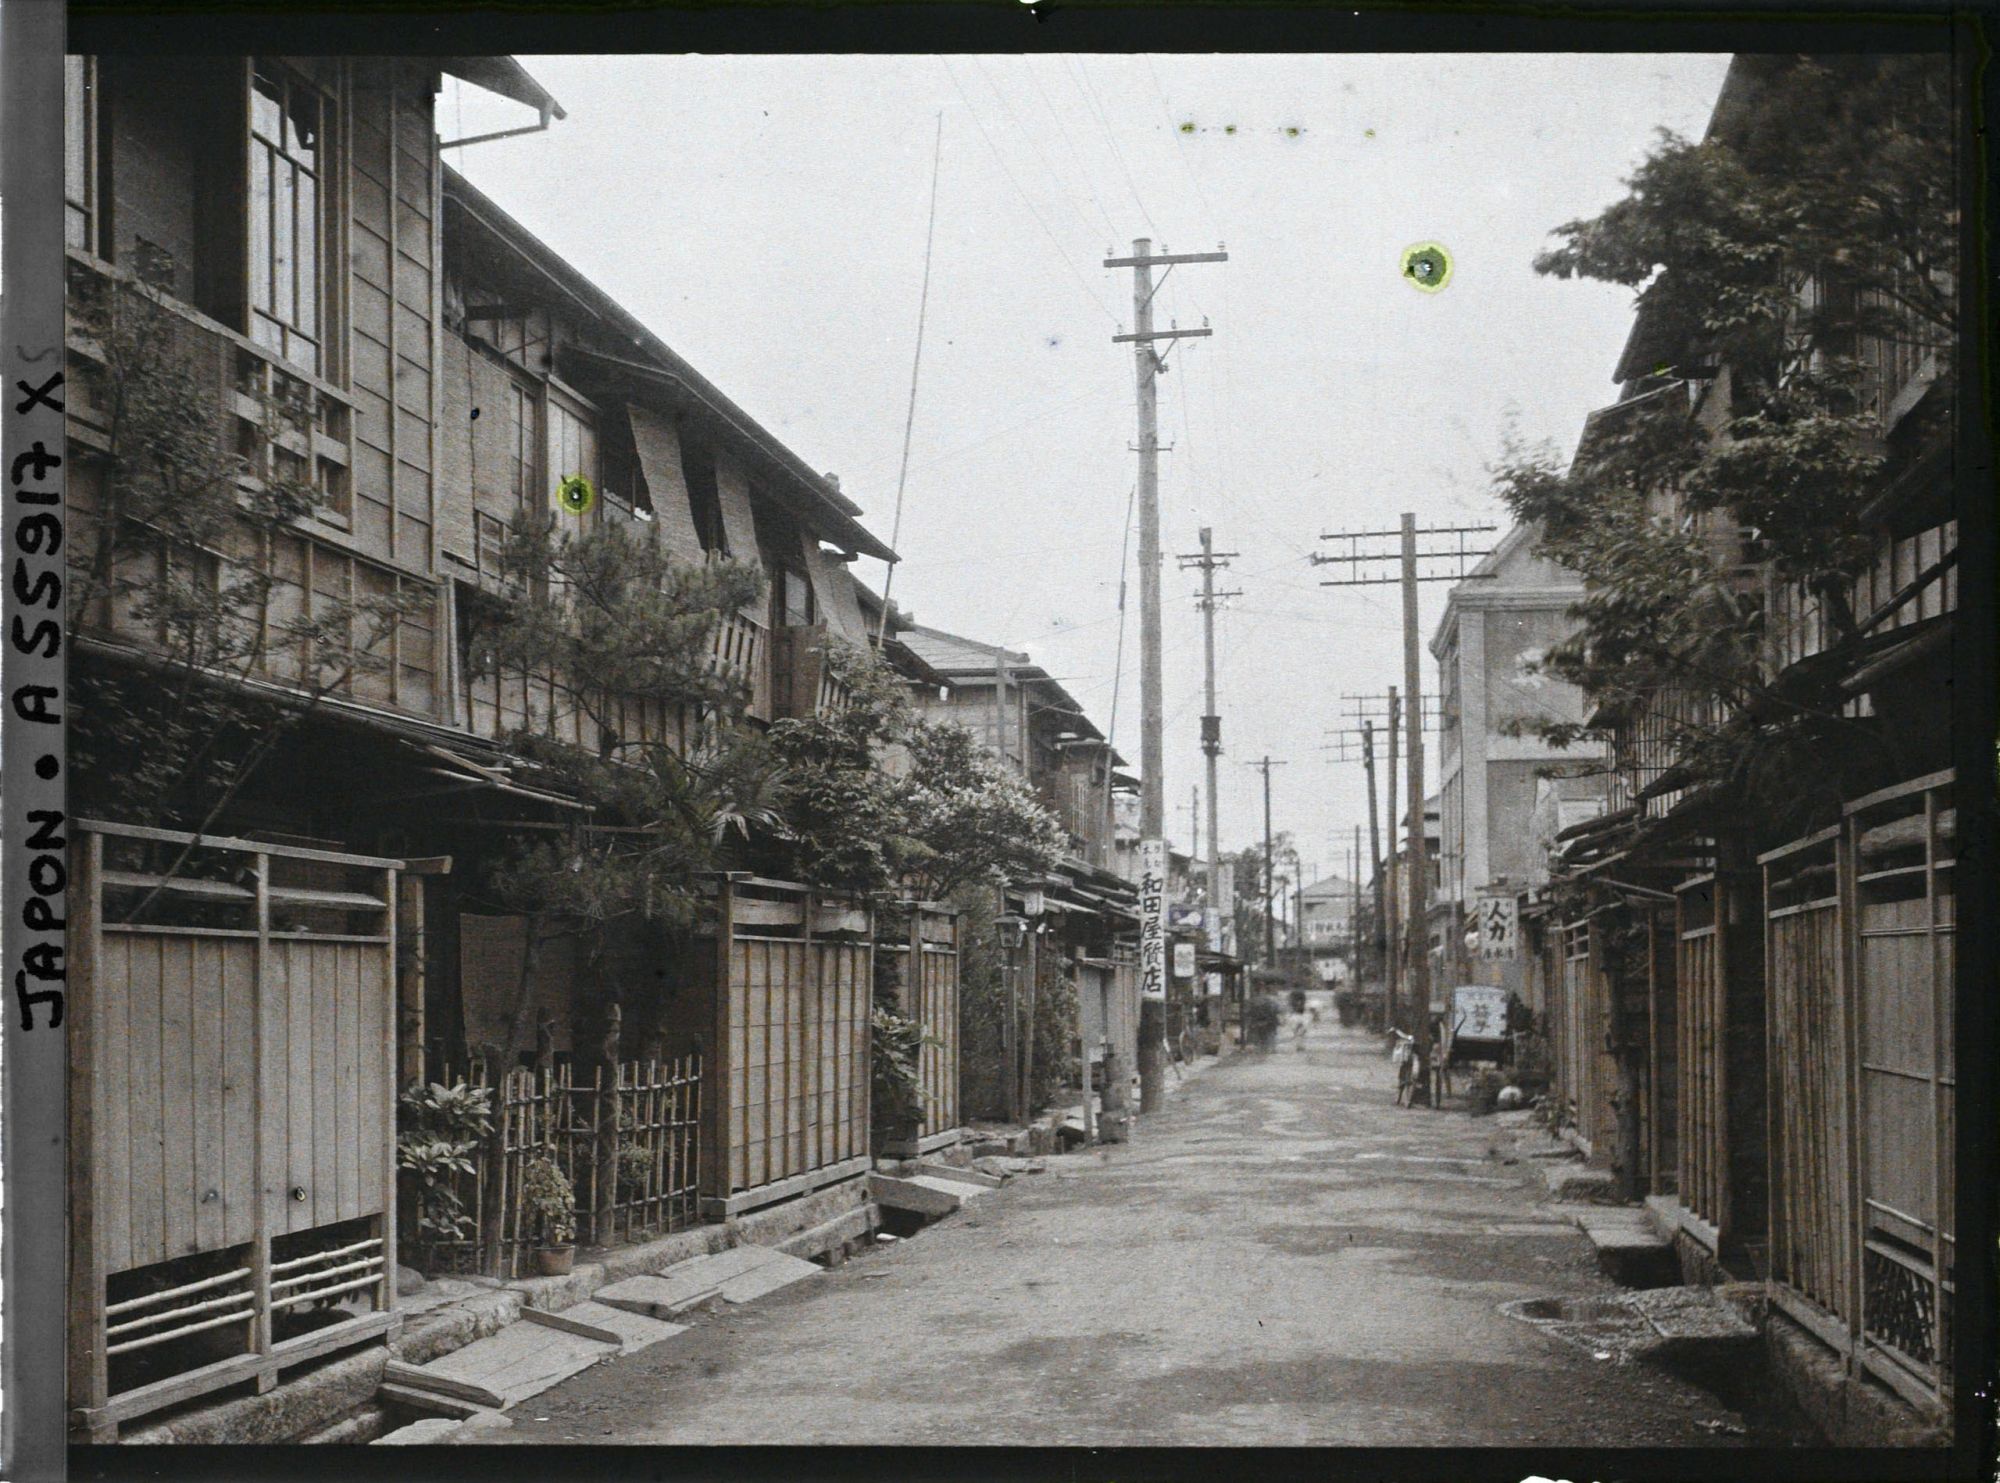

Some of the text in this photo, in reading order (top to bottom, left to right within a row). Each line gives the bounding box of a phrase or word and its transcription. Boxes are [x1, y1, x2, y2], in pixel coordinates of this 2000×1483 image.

[15, 371, 66, 416] X
[11, 683, 62, 725] A
[15, 810, 67, 1032] JAPON
[1141, 871, 1164, 993] 和田屋質店
[1488, 900, 1508, 941] 人力
